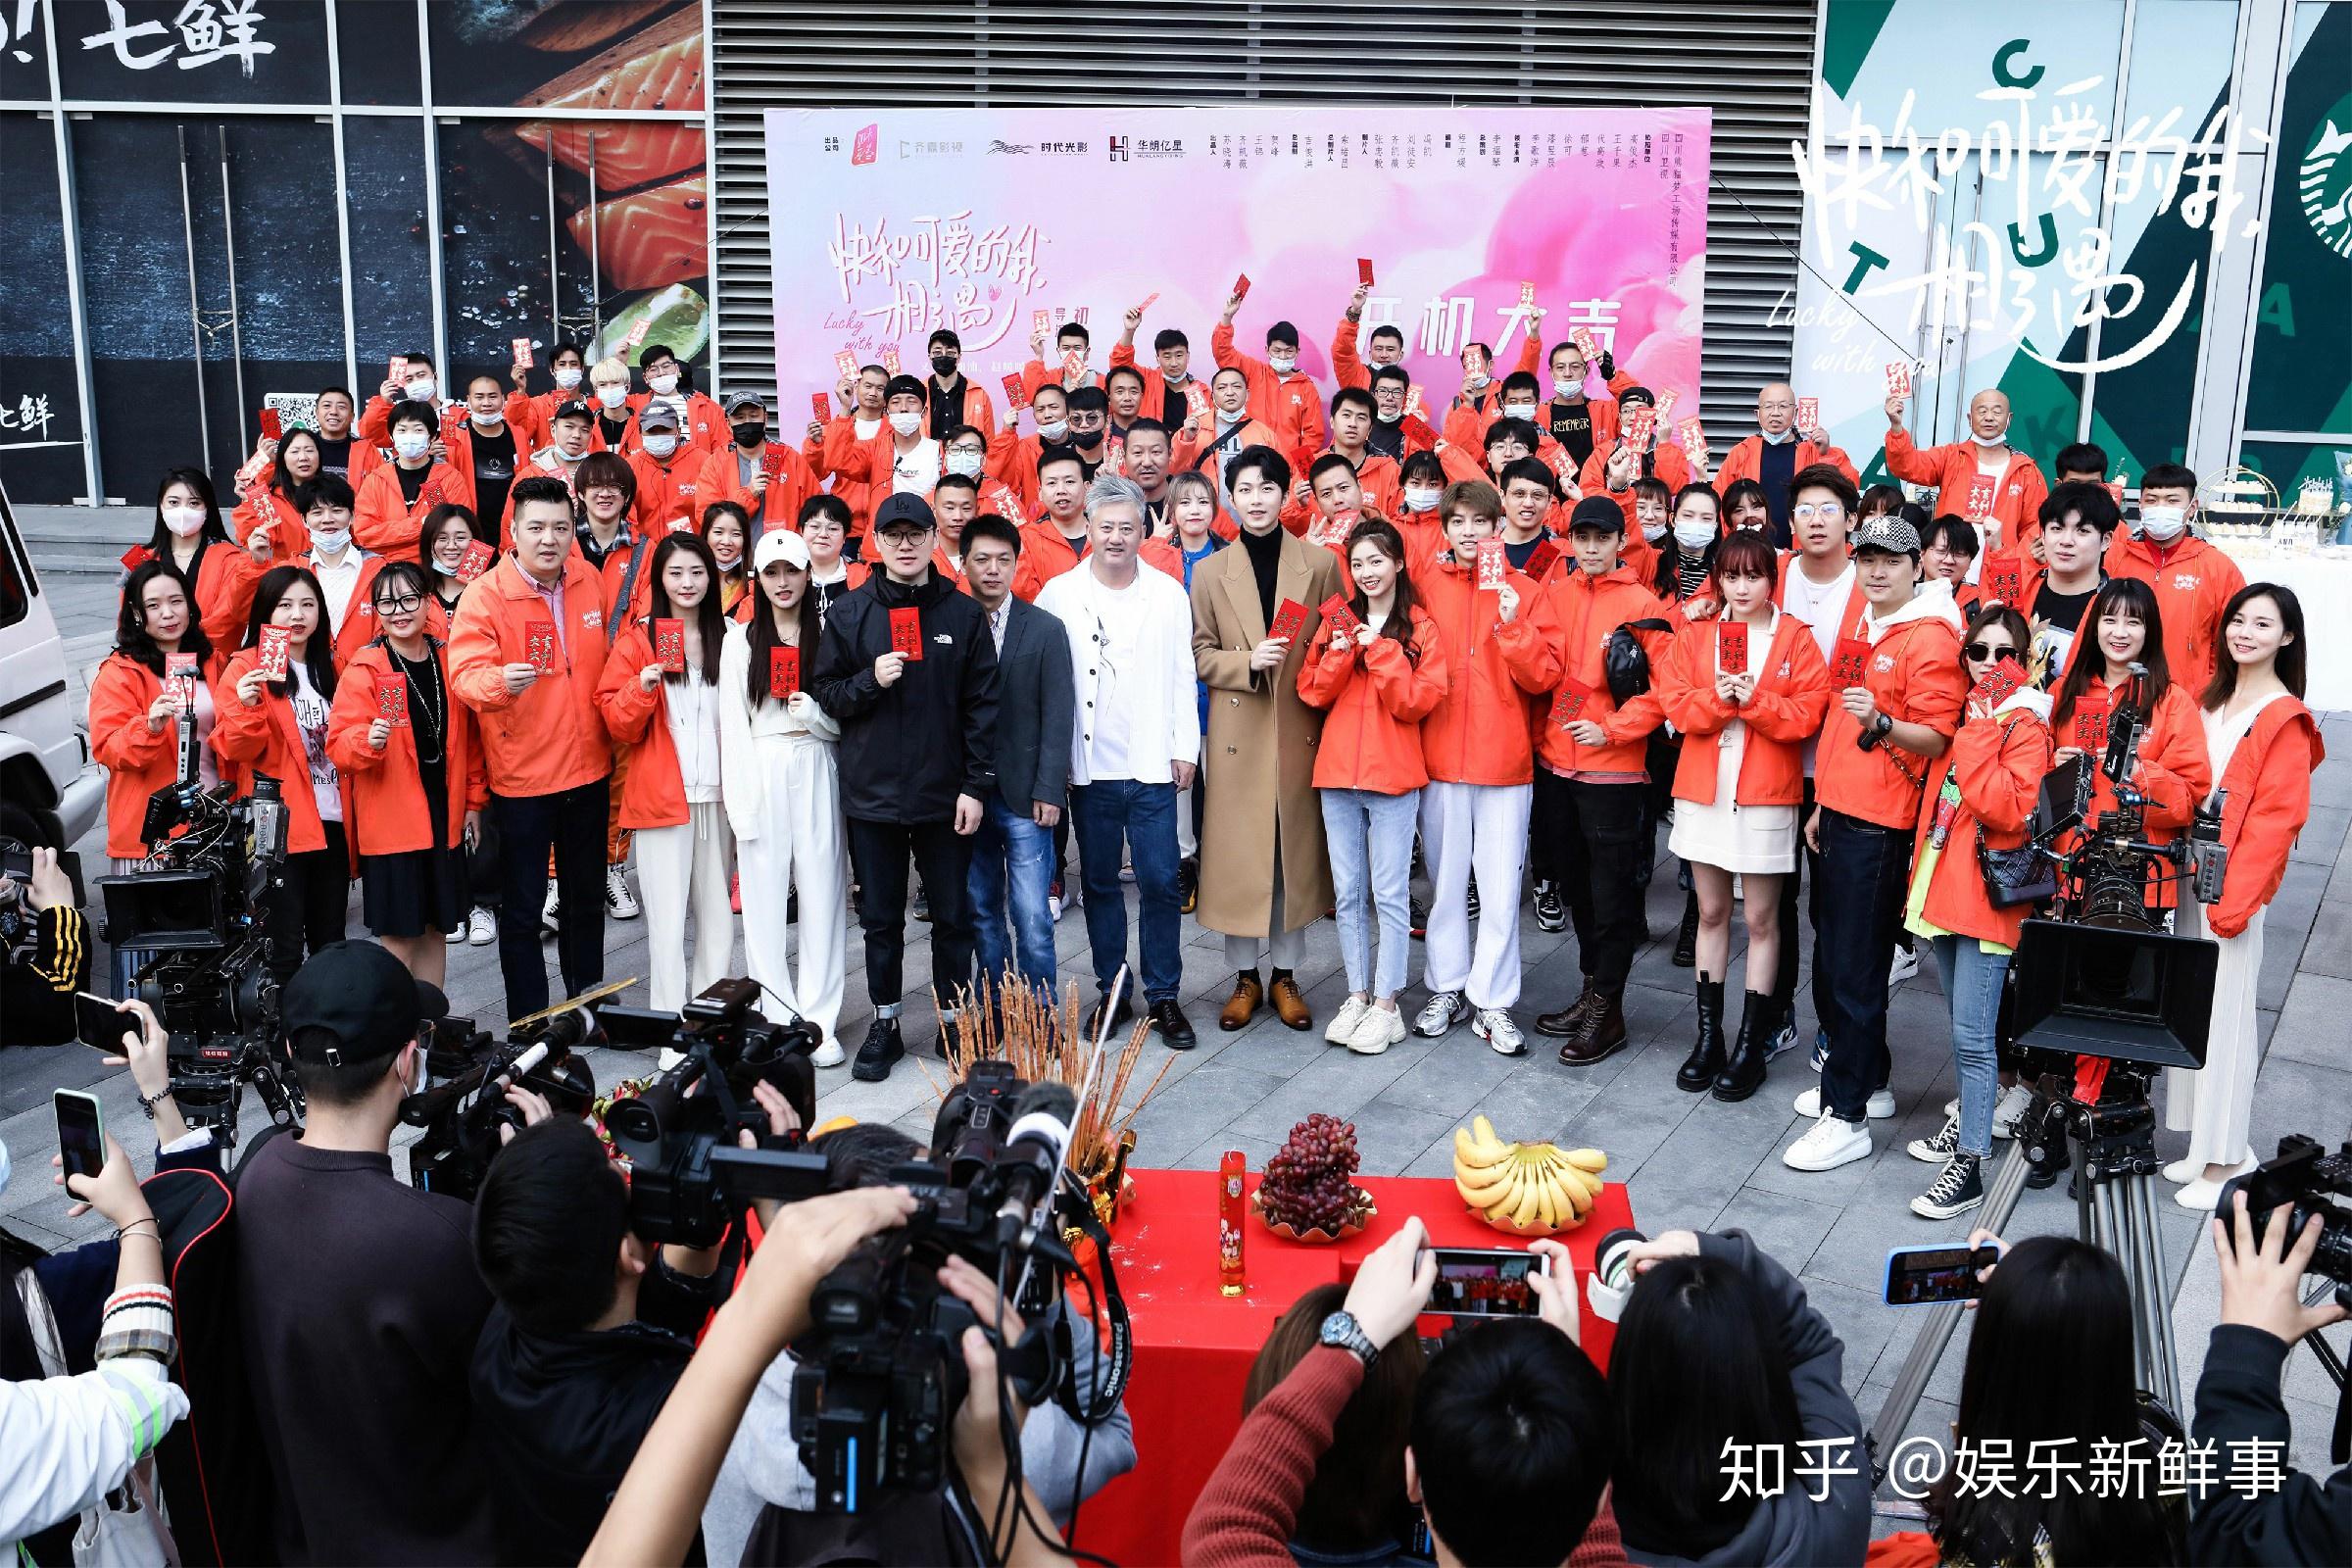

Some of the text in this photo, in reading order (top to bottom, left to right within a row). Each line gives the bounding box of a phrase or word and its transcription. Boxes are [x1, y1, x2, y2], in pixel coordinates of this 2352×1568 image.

[80, 0, 276, 78] 七鲜
[1992, 38, 2045, 88] C
[1041, 142, 1089, 153] 时代光影
[1137, 139, 1184, 152] 华朗亿星
[1841, 242, 1889, 295] T
[823, 310, 864, 336] Lucky
[2259, 282, 2296, 337] A
[844, 335, 873, 350] with
[1103, 1321, 1124, 1397] Panasonic
